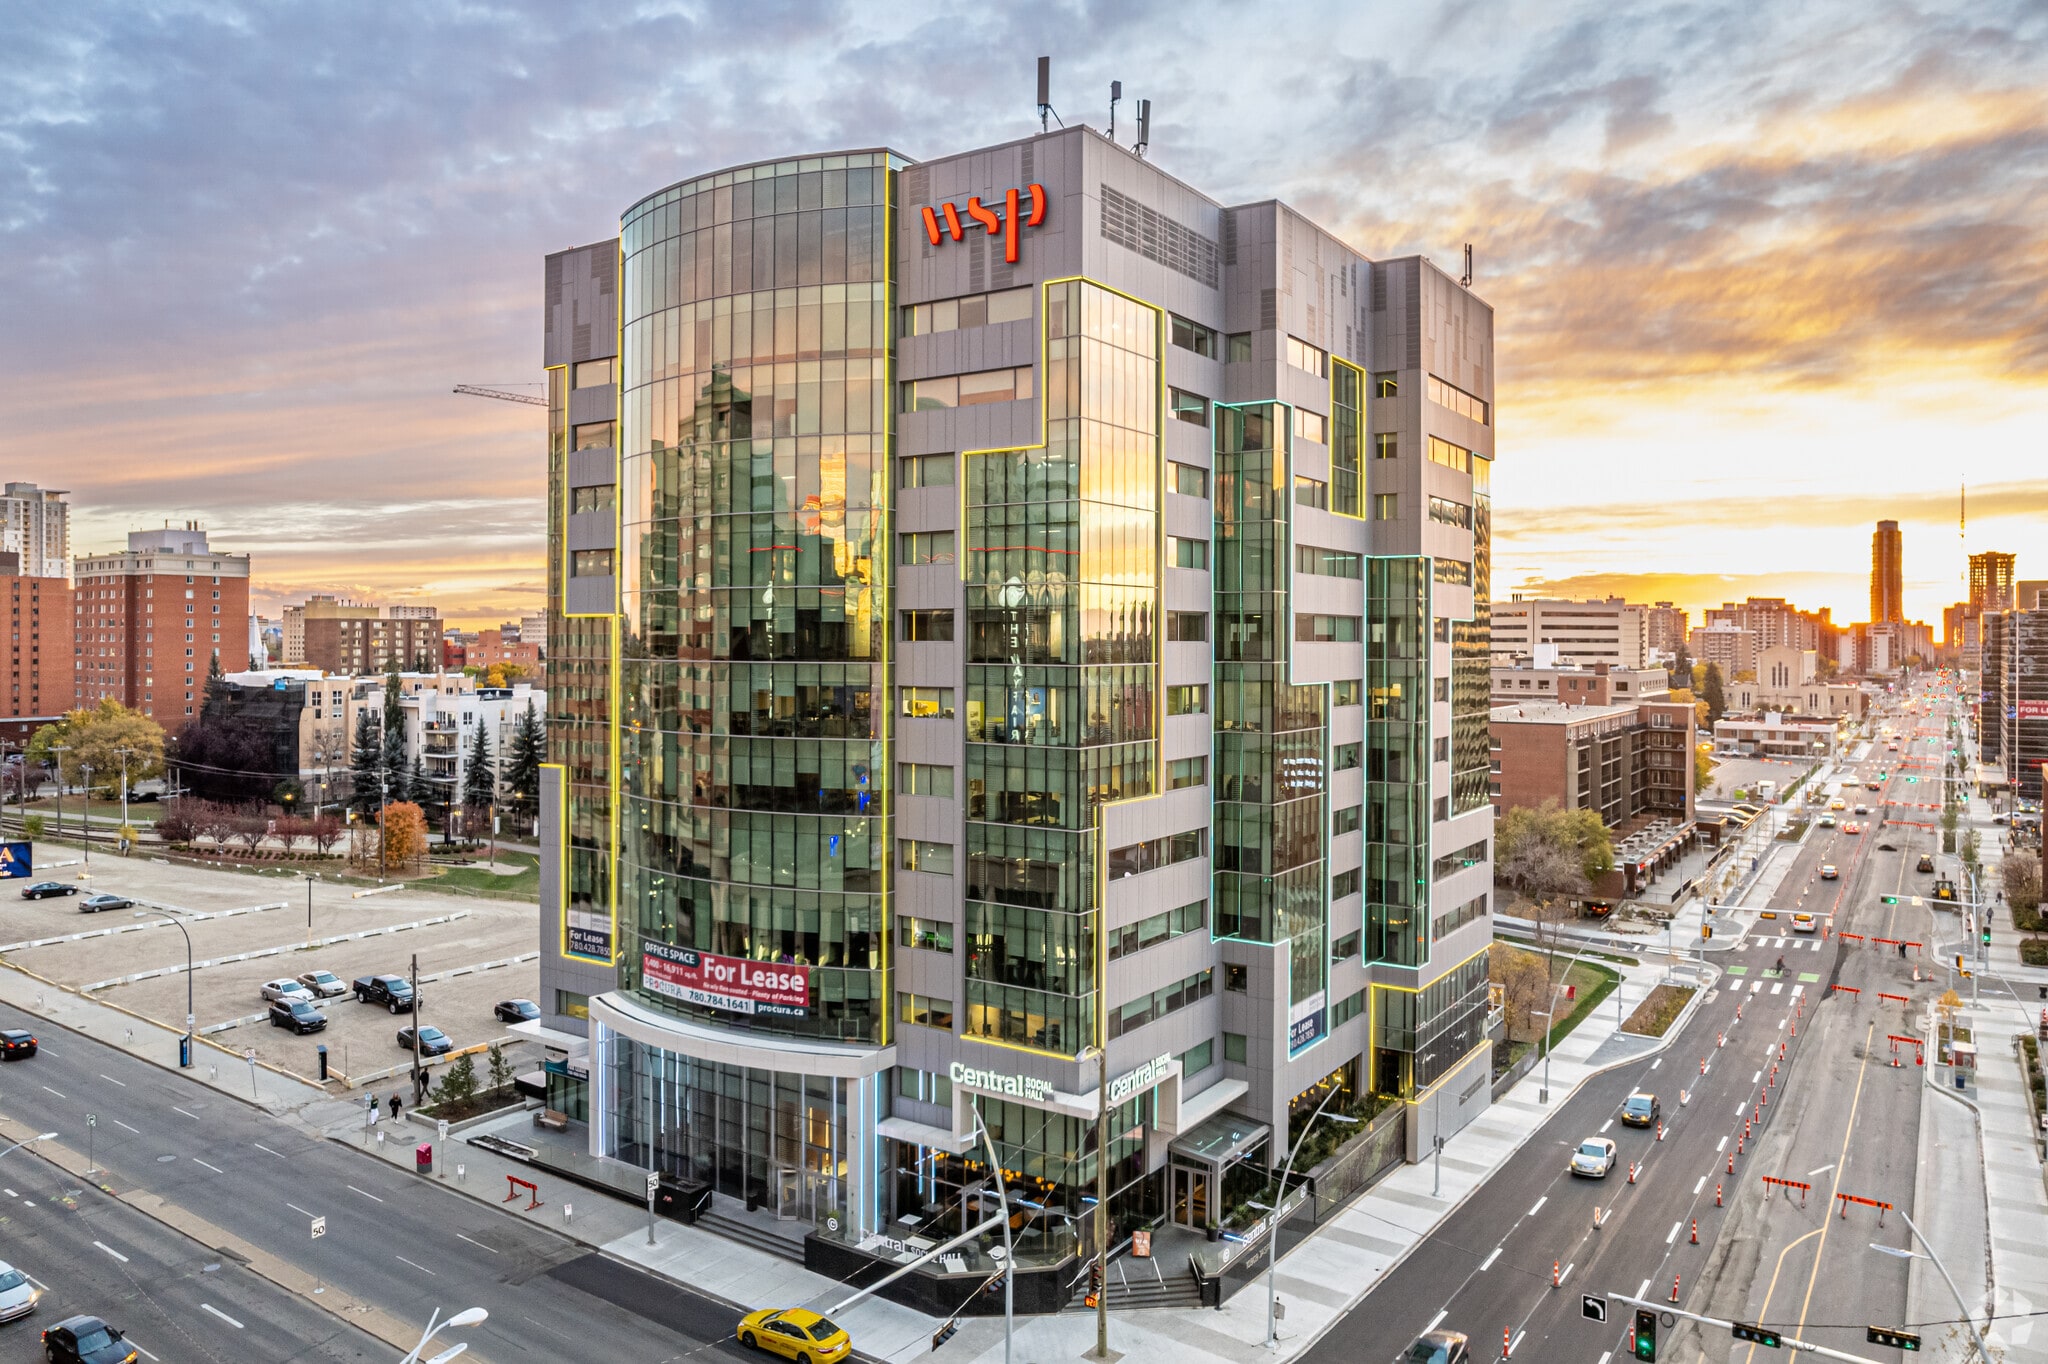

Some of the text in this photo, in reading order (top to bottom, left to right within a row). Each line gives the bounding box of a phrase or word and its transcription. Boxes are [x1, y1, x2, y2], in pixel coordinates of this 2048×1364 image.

[921, 184, 1047, 264] wsp
[570, 930, 604, 944] For Lease
[644, 942, 696, 964] OFFICE SPACE
[704, 957, 805, 992] For Lease
[645, 976, 682, 997] PROCURA
[752, 990, 771, 1000] Plenty
[780, 994, 804, 1004] Parking
[689, 990, 750, 1011] 780.784.1641
[758, 1004, 804, 1016] procura.ca
[950, 1062, 1054, 1098] Central SOCIAL
[1110, 1060, 1156, 1101] Central
[1025, 1088, 1044, 1102] HALL
[649, 1179, 658, 1188] 50
[313, 1226, 324, 1236] 50
